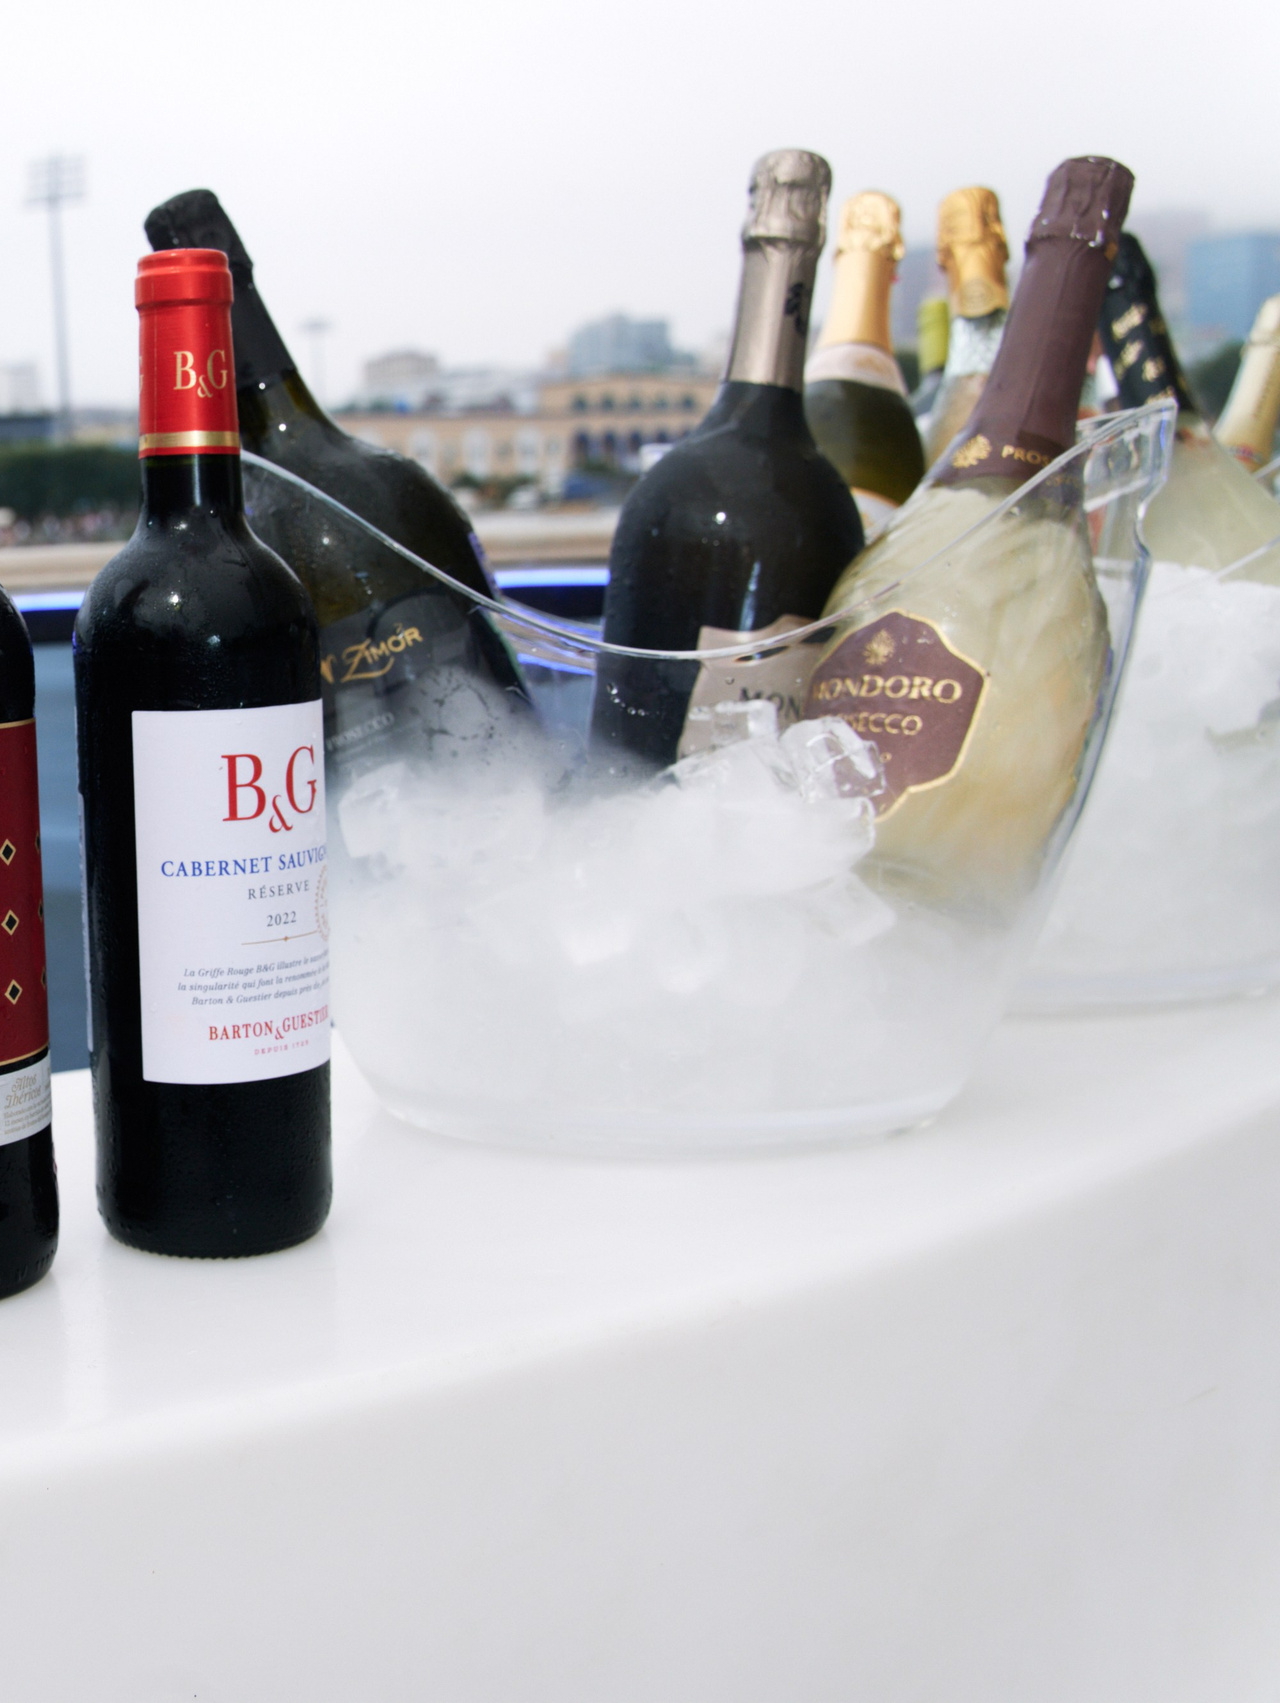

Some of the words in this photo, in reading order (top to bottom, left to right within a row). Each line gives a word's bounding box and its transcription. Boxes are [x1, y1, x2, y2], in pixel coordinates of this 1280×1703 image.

[173, 349, 228, 398] B&G
[221, 744, 318, 833] B&G
[161, 856, 273, 877] CABERNET
[278, 846, 327, 871] SAUVIG
[248, 879, 310, 901] RÉSERVE
[266, 911, 297, 928] 2022
[183, 968, 196, 977] La
[198, 967, 225, 979] Griffe
[227, 966, 254, 977] Rouge
[277, 958, 302, 971] illustre
[177, 982, 187, 991] la
[189, 982, 240, 993] singularité
[241, 979, 256, 990] qui
[257, 977, 274, 990] font
[191, 995, 224, 1006] Barton
[226, 996, 233, 1004] &
[236, 992, 272, 1004] Guestier
[273, 988, 298, 1000] depuis
